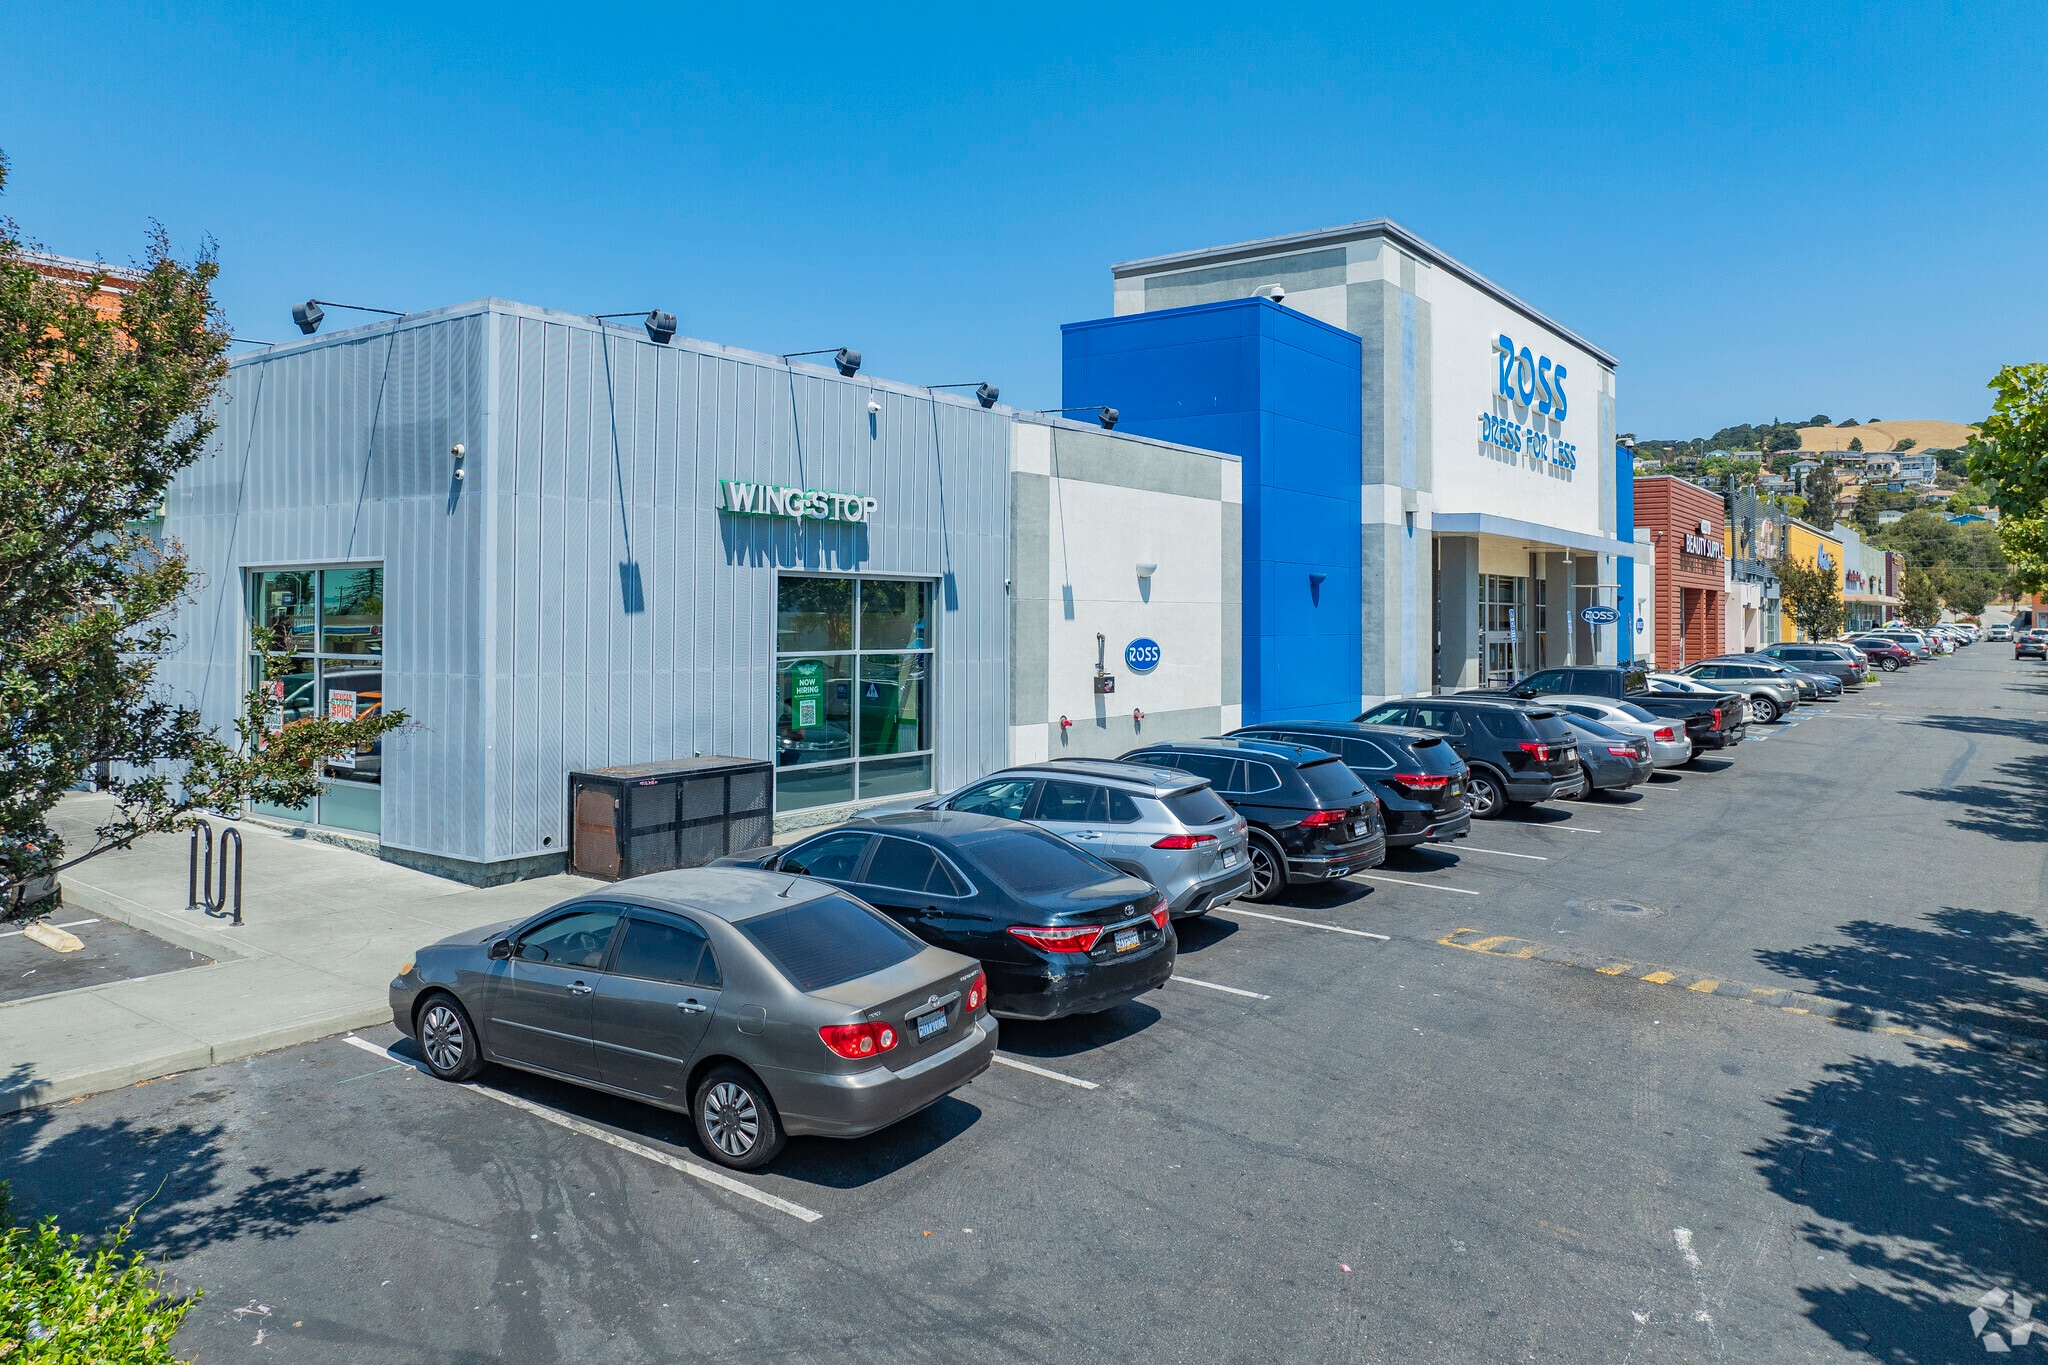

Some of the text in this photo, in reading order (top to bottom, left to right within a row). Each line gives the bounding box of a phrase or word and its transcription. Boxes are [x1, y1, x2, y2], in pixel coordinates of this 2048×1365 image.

[1494, 333, 1568, 422] ROSS
[1480, 412, 1577, 471] DRESS FOR LESS
[1686, 534, 1724, 559] BEAUTY SUPPLY
[1585, 610, 1614, 621] ROSS
[1129, 647, 1158, 662] ROSS
[333, 692, 352, 700] MEXICAN
[796, 686, 819, 694] HIRING
[331, 698, 354, 706] STREET
[332, 704, 353, 718] SPICE
